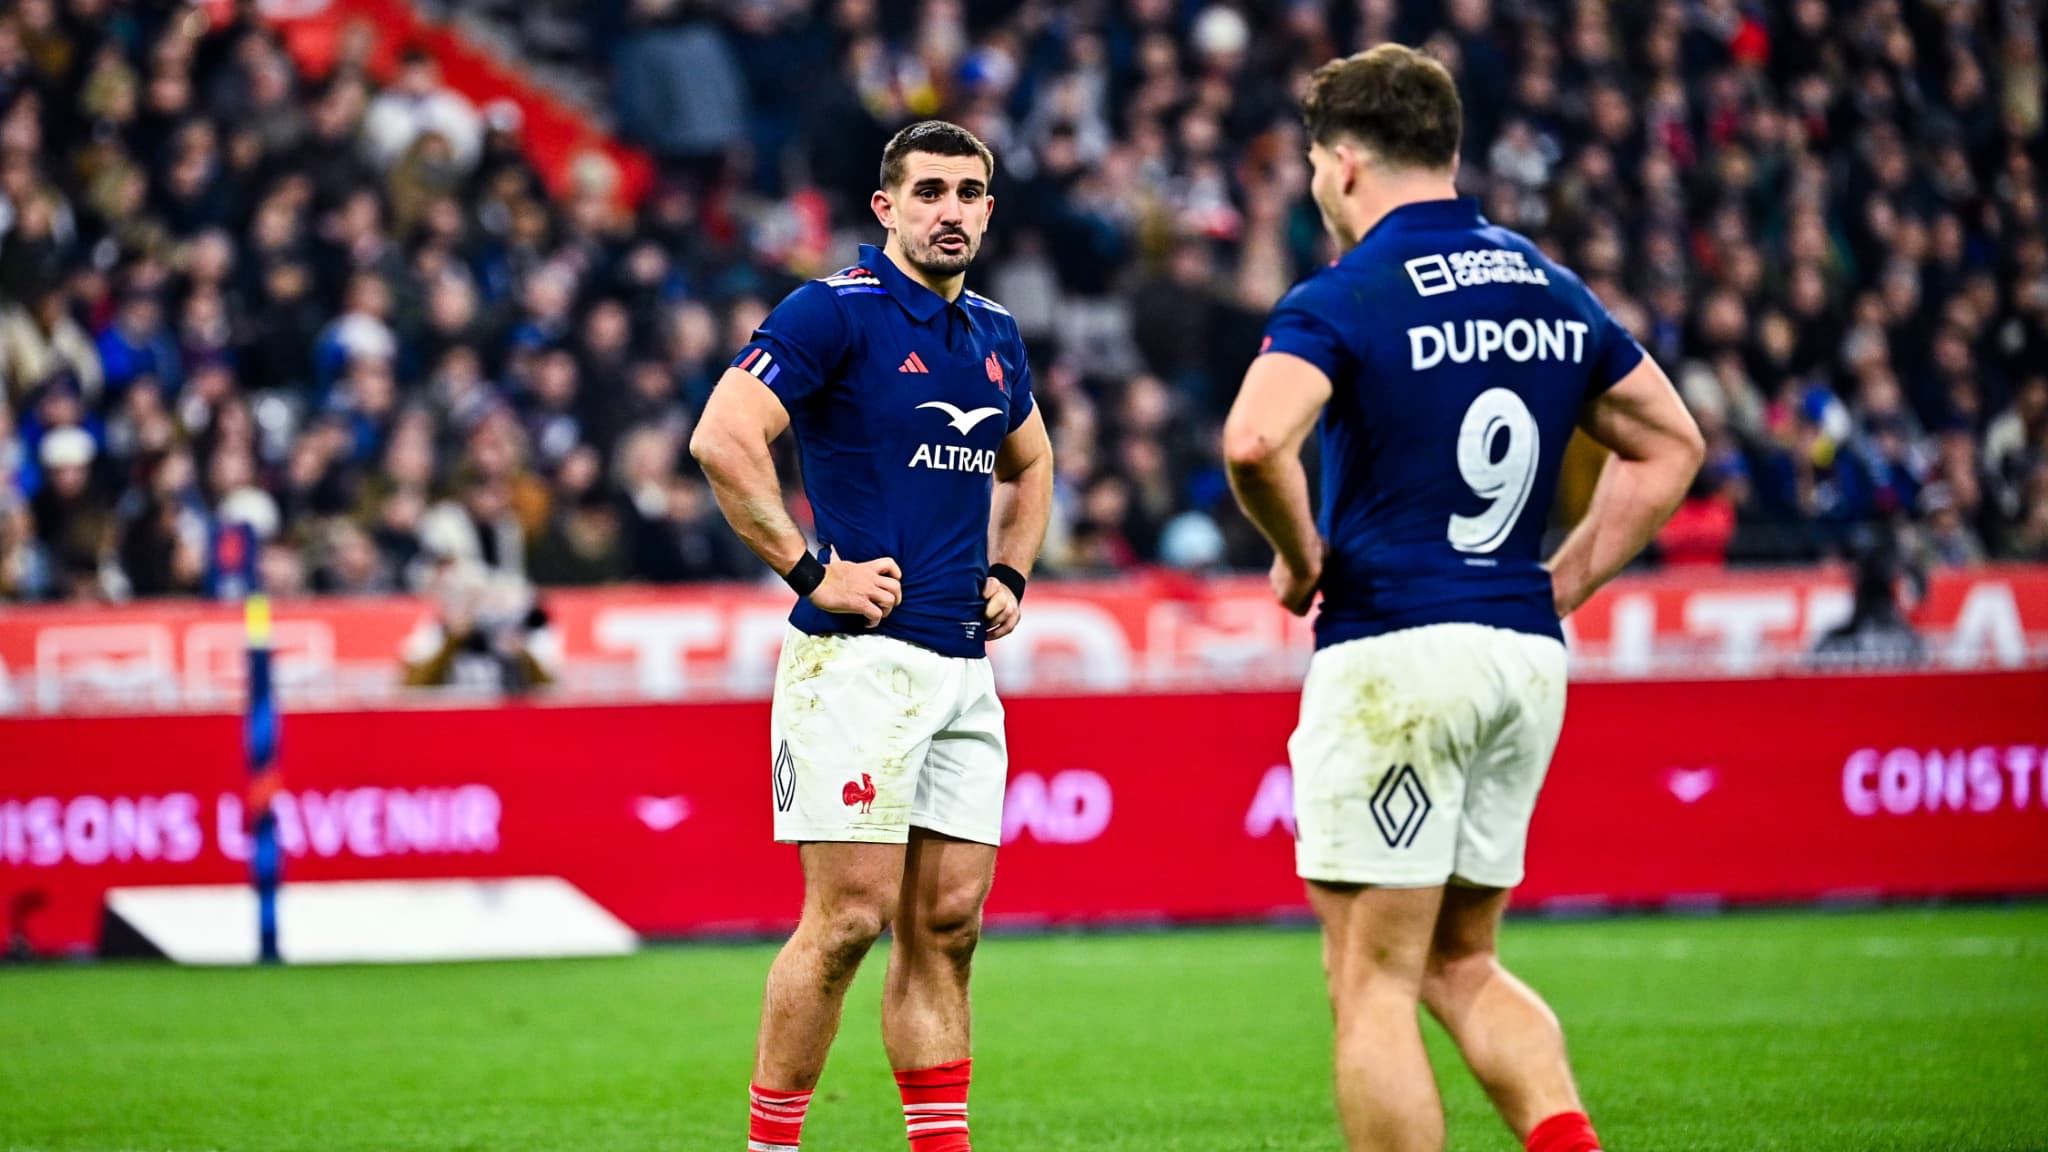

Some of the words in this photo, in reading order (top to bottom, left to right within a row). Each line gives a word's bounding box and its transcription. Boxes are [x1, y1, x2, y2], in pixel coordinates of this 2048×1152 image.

[1408, 318, 1588, 371] DUPONT
[908, 443, 996, 474] ALTRAD
[1447, 387, 1540, 554] 9
[1843, 746, 2048, 815] CONST
